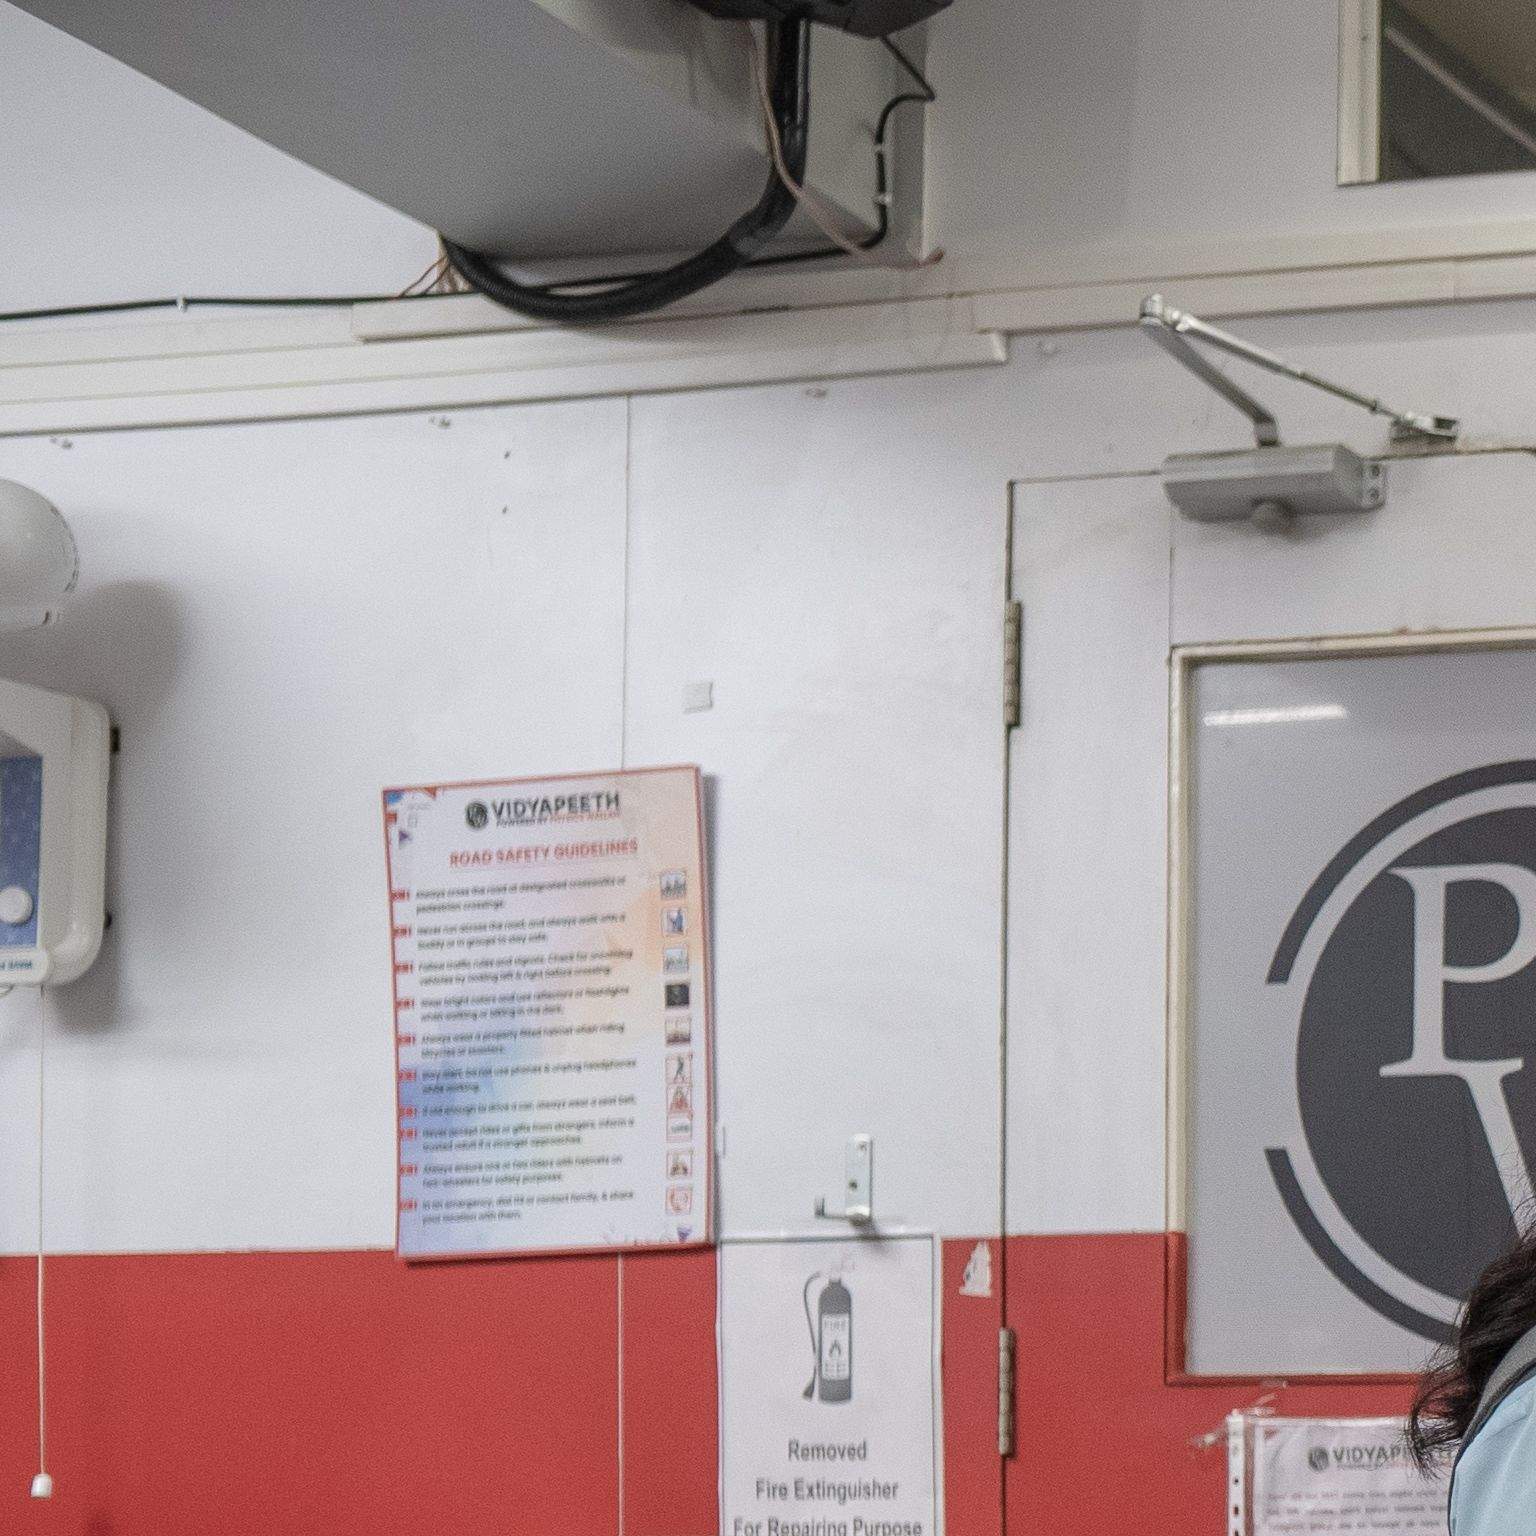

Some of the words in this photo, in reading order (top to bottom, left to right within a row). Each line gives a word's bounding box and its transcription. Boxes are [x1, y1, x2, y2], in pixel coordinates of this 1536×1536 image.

[492, 792, 621, 819] VIDYAPEETH
[450, 851, 492, 866] ROAD
[496, 846, 550, 862] SAFETY
[554, 838, 639, 860] GUIDELINES
[788, 1439, 867, 1461] Removed
[756, 1479, 788, 1500] Fire
[794, 1479, 898, 1505] Extinguisher
